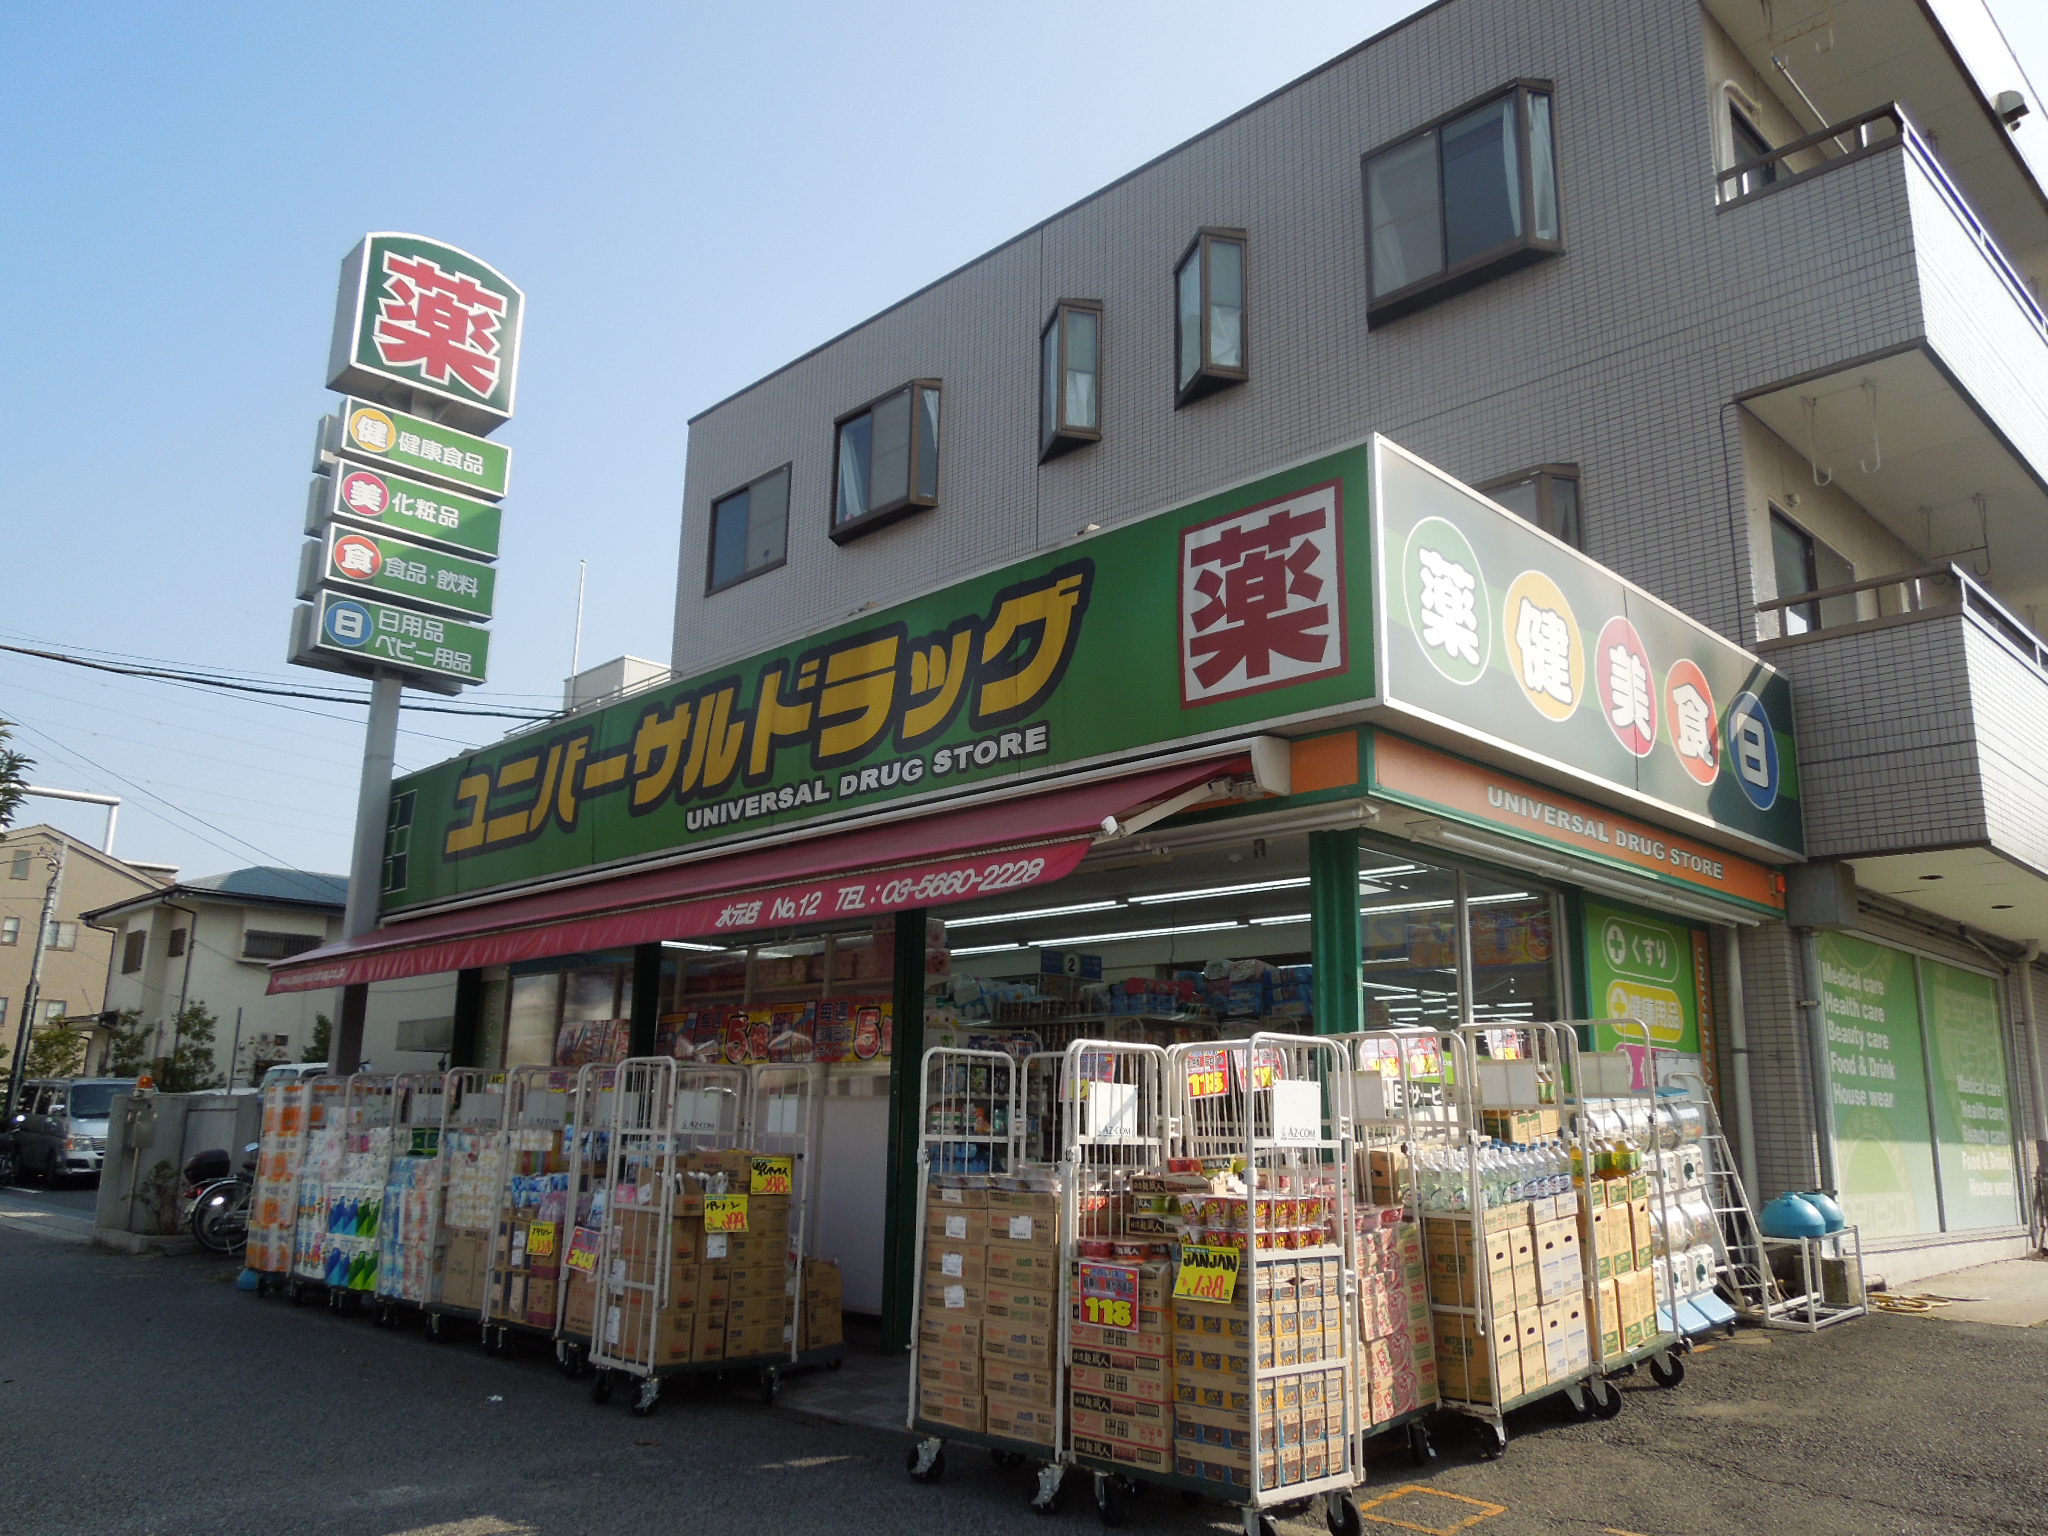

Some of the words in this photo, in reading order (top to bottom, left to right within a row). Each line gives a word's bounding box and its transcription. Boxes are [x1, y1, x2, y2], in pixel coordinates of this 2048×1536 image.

[373, 251, 507, 398] 薬
[356, 415, 389, 449] 健
[398, 431, 484, 475] 健康食品
[350, 480, 382, 512] 美
[392, 492, 459, 529] 化粧品
[341, 543, 375, 574] 食
[1190, 507, 1330, 690] 薬
[334, 609, 364, 639] 日
[378, 609, 444, 643] 日用品
[375, 635, 472, 673] ベビー用品
[1418, 547, 1482, 667] 薬
[1515, 599, 1575, 707] 健
[1607, 644, 1652, 742] 美
[1672, 683, 1714, 768] 食
[1735, 711, 1769, 788] 日
[446, 574, 1084, 855] ユニバーサルドラッグ
[686, 779, 830, 830] UNIVERSAL
[839, 758, 923, 797] DRUG
[932, 725, 1047, 774] STORE
[1487, 785, 1610, 843] UNIVERSAL
[1615, 829, 1666, 860] DRUG
[1670, 848, 1724, 880] STORE
[715, 901, 763, 927] 水元店
[770, 891, 822, 921] No.12
[1068, 958, 1076, 972] 2
[1632, 935, 1667, 968] くすり
[1822, 962, 1862, 991] Medical
[1863, 977, 1885, 995] care
[1824, 991, 1861, 1017] Health
[1862, 1004, 1885, 1022] care
[1827, 1020, 1864, 1050] Beauty
[1866, 1031, 1890, 1050] care
[1830, 1051, 1857, 1075] Food
[1858, 1056, 1867, 1076] &
[1869, 1057, 1896, 1080] Drink
[1832, 1082, 1867, 1106] House
[1868, 1091, 1894, 1108] wear
[1103, 1125, 1131, 1136] AZ-COM
[1287, 1127, 1316, 1138] AZ-COM
[1183, 1252, 1238, 1272] JANJAN
[1084, 1297, 1132, 1327] 118
